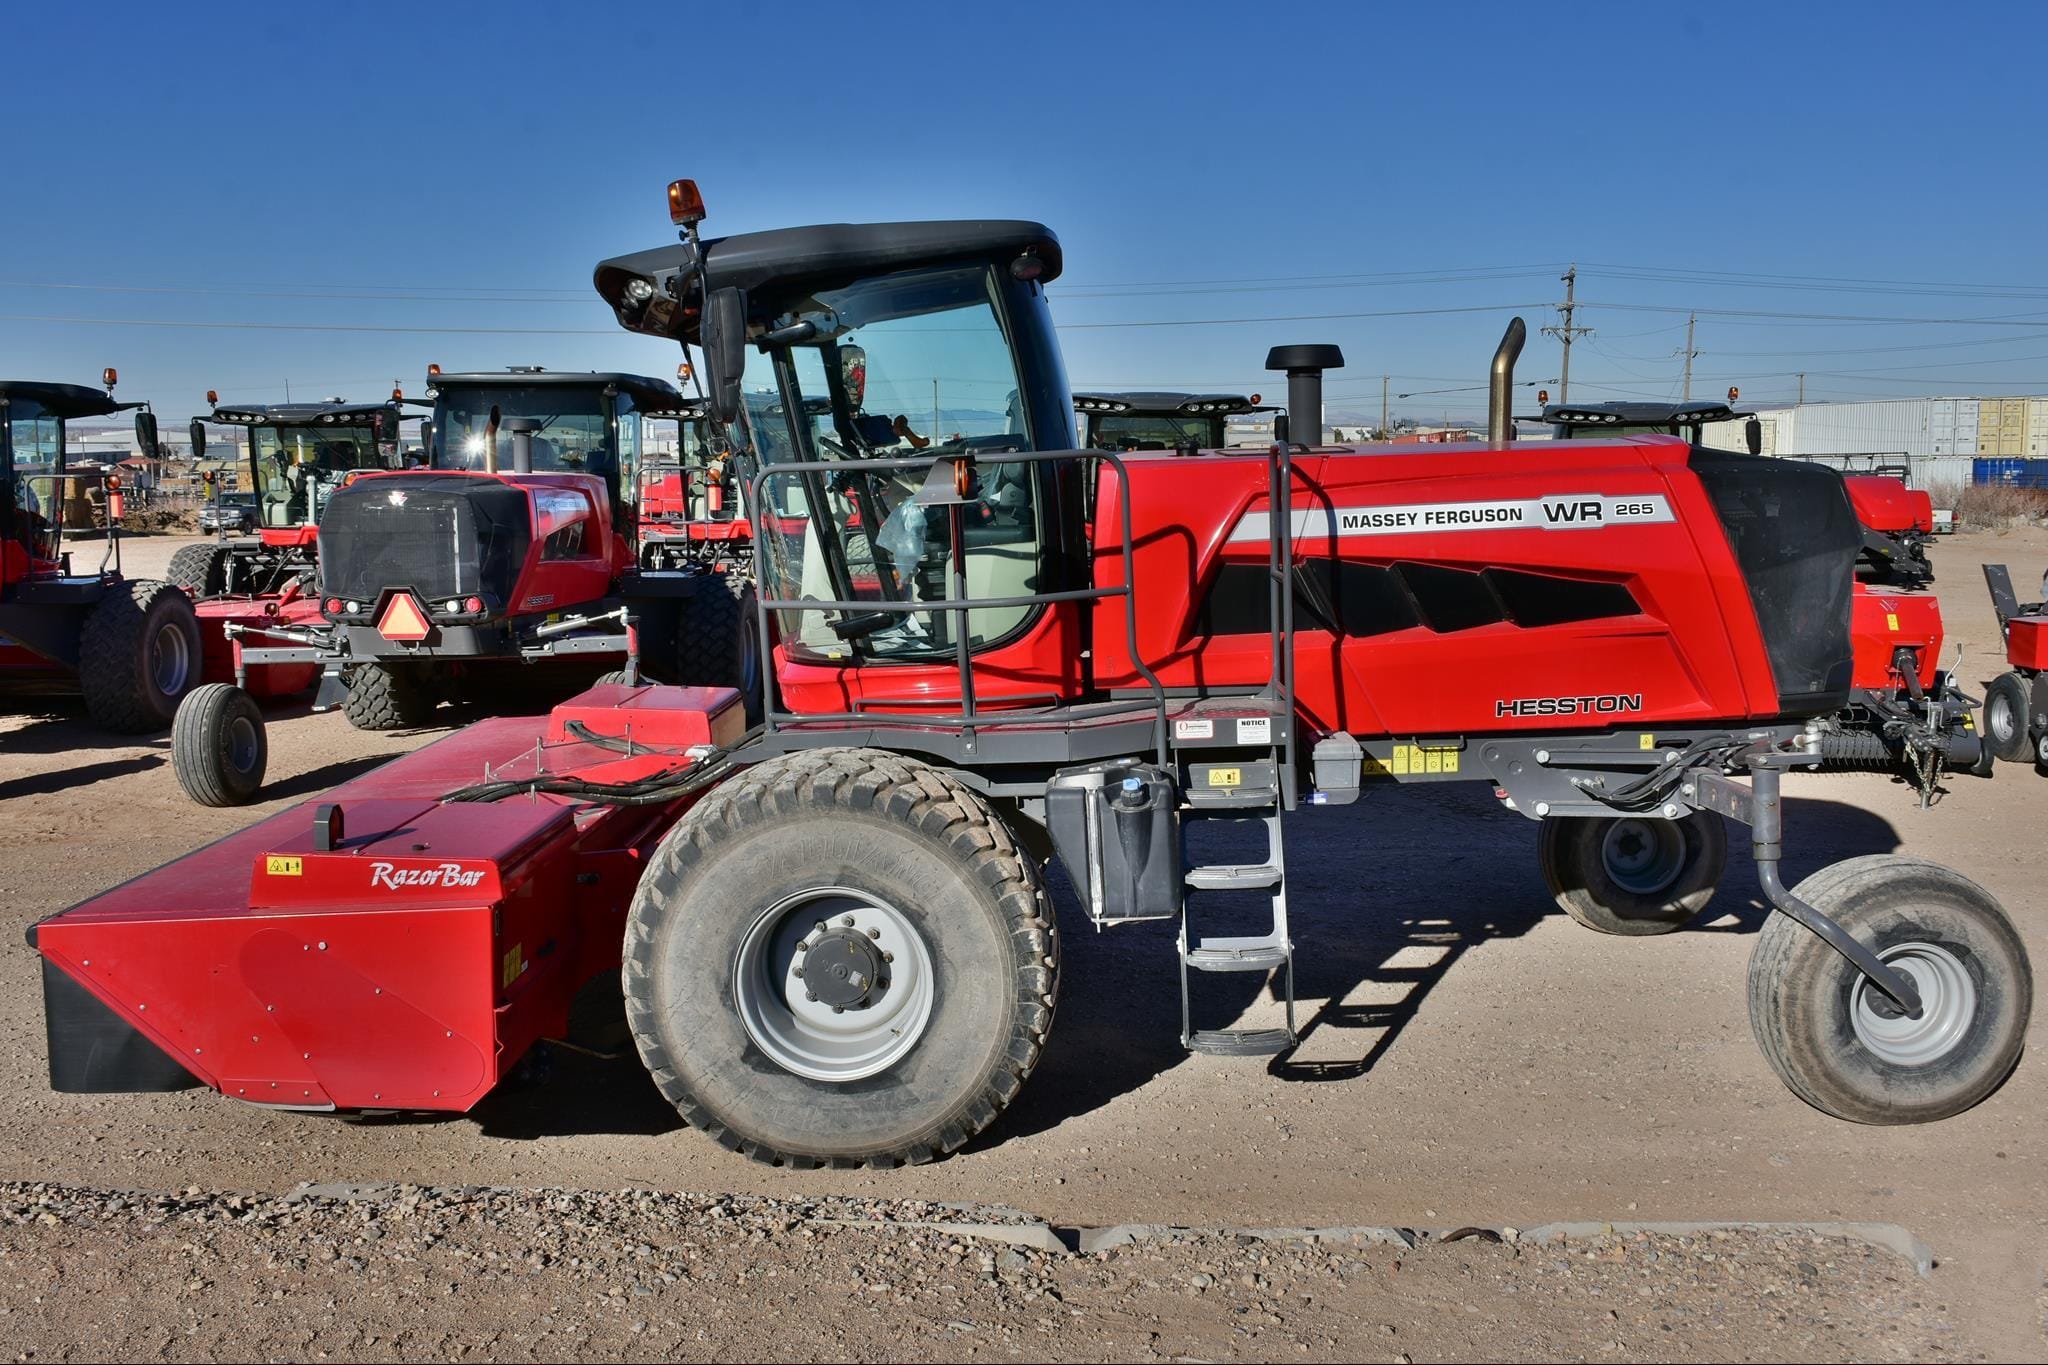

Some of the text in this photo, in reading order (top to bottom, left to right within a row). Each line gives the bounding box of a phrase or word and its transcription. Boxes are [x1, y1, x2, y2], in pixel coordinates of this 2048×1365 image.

[1342, 501, 1655, 529] MASSEY FERGUSON WR 265
[1496, 694, 1642, 717] HESSTON
